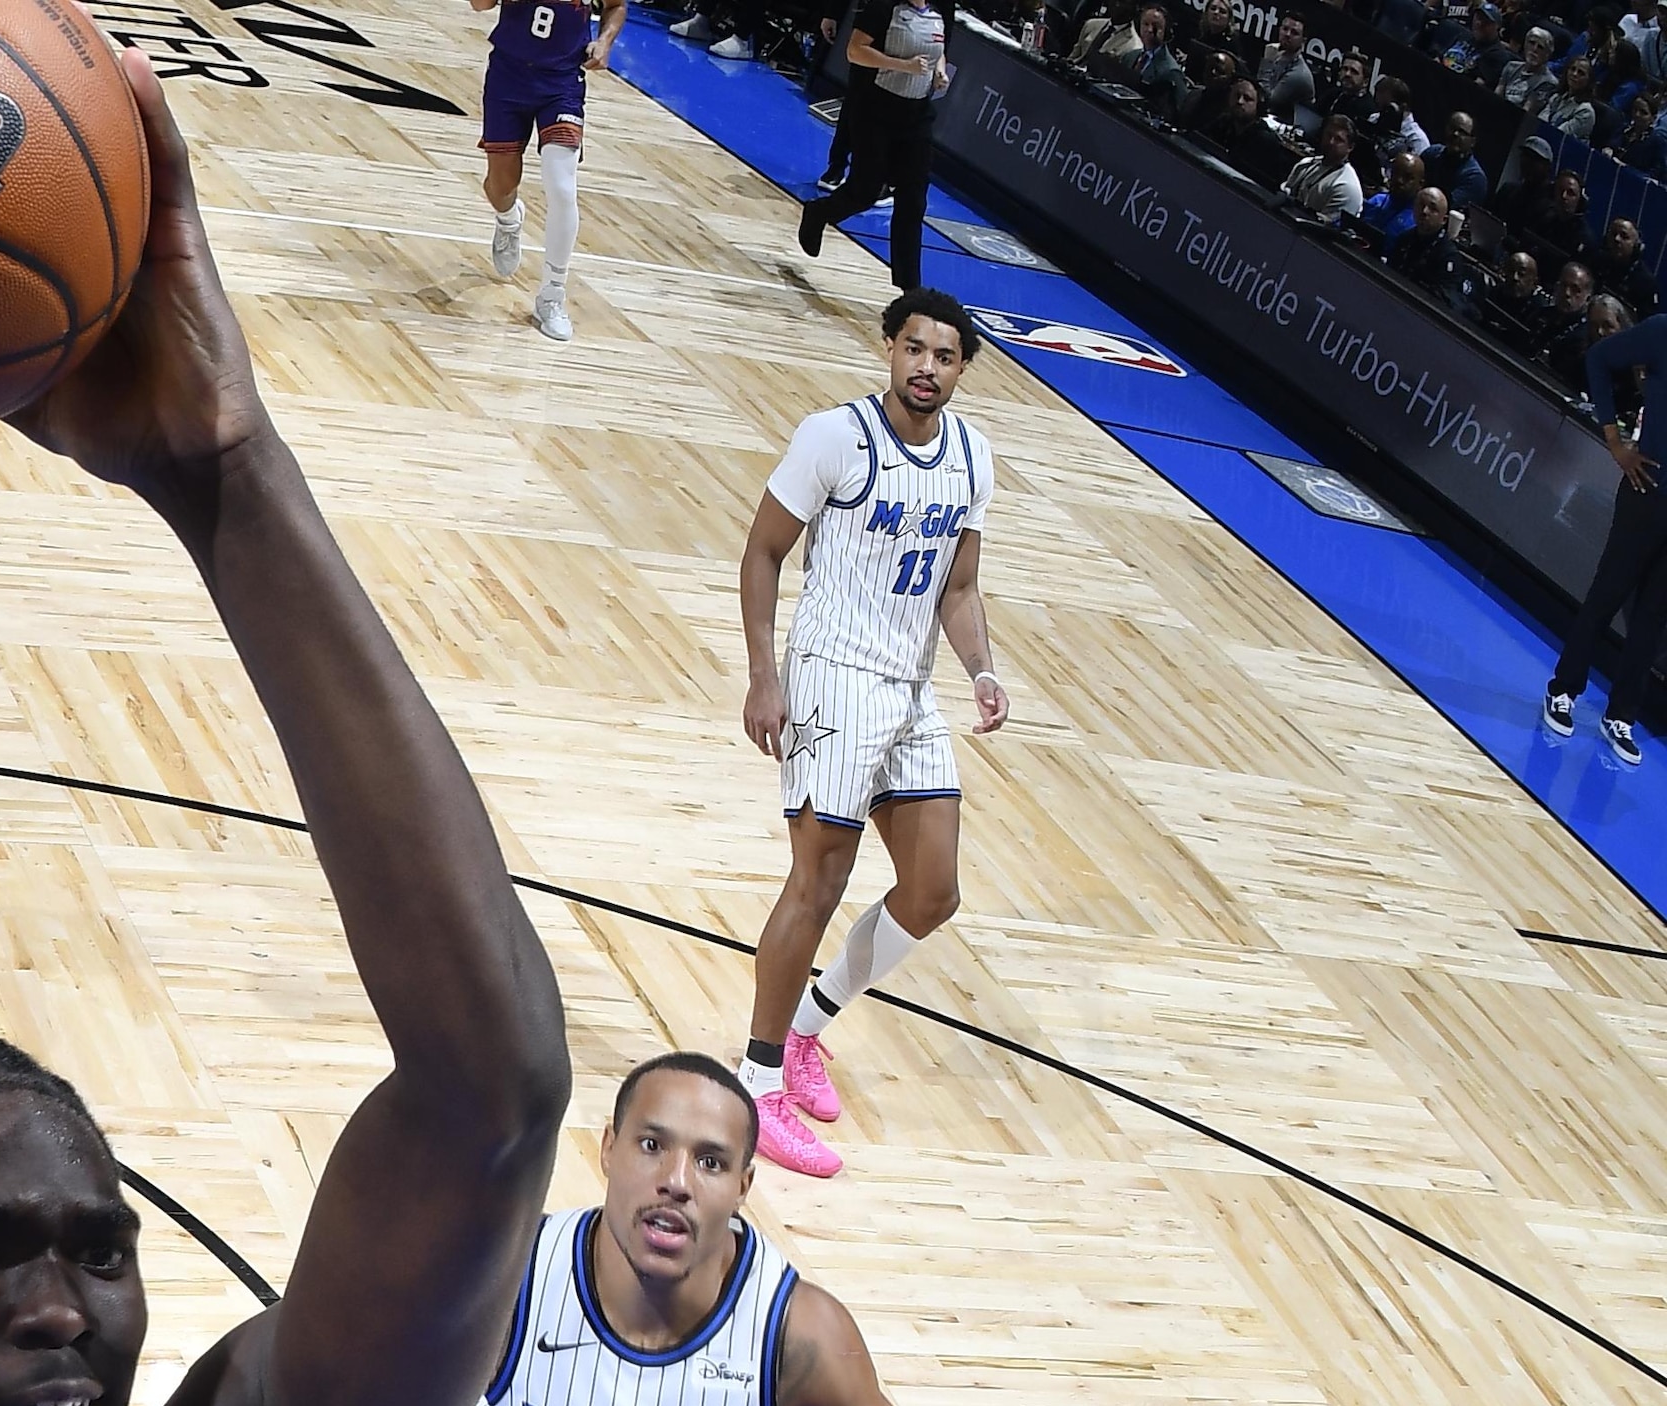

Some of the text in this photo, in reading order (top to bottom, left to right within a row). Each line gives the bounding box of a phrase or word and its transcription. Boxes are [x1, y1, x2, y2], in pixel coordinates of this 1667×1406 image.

[531, 6, 555, 39] 8
[975, 85, 1535, 492] The all-new Kia Telluride Turbo-Hybrid
[891, 548, 938, 596] 13
[697, 1357, 755, 1389] Disney
